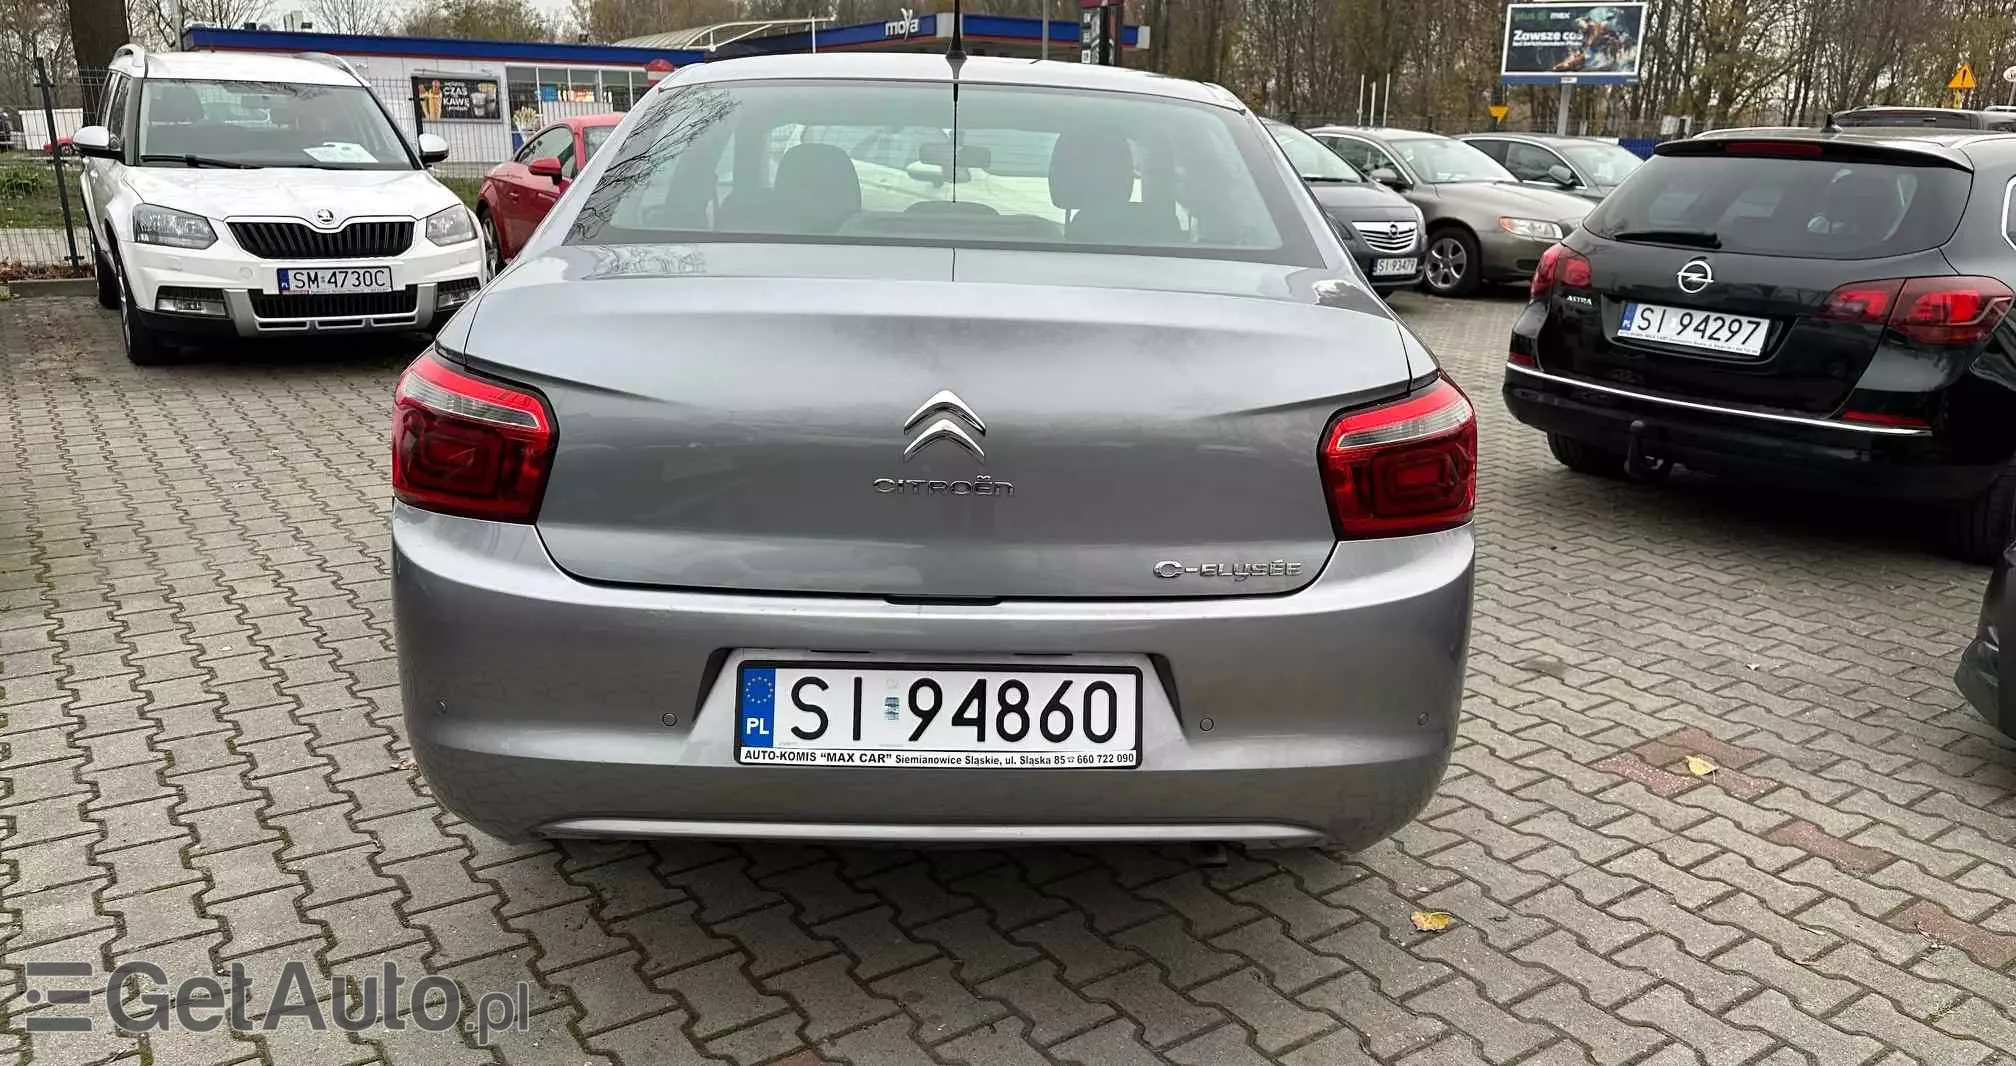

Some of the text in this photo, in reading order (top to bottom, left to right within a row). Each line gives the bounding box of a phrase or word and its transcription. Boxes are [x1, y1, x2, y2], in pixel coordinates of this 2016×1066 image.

[1513, 30, 1561, 40] Zawsze
[293, 270, 386, 289] SM 4730C
[1637, 306, 1666, 333] SI
[1676, 311, 1760, 345] 94297
[791, 677, 1118, 743] SI 94860
[746, 717, 770, 735] PL
[744, 750, 817, 762] AUTO-KOMIS
[895, 754, 962, 765] Siemianowice
[1004, 755, 1017, 766] ul.
[1077, 754, 1095, 764] 660
[1097, 753, 1114, 764] 722
[1116, 753, 1134, 763] 090
